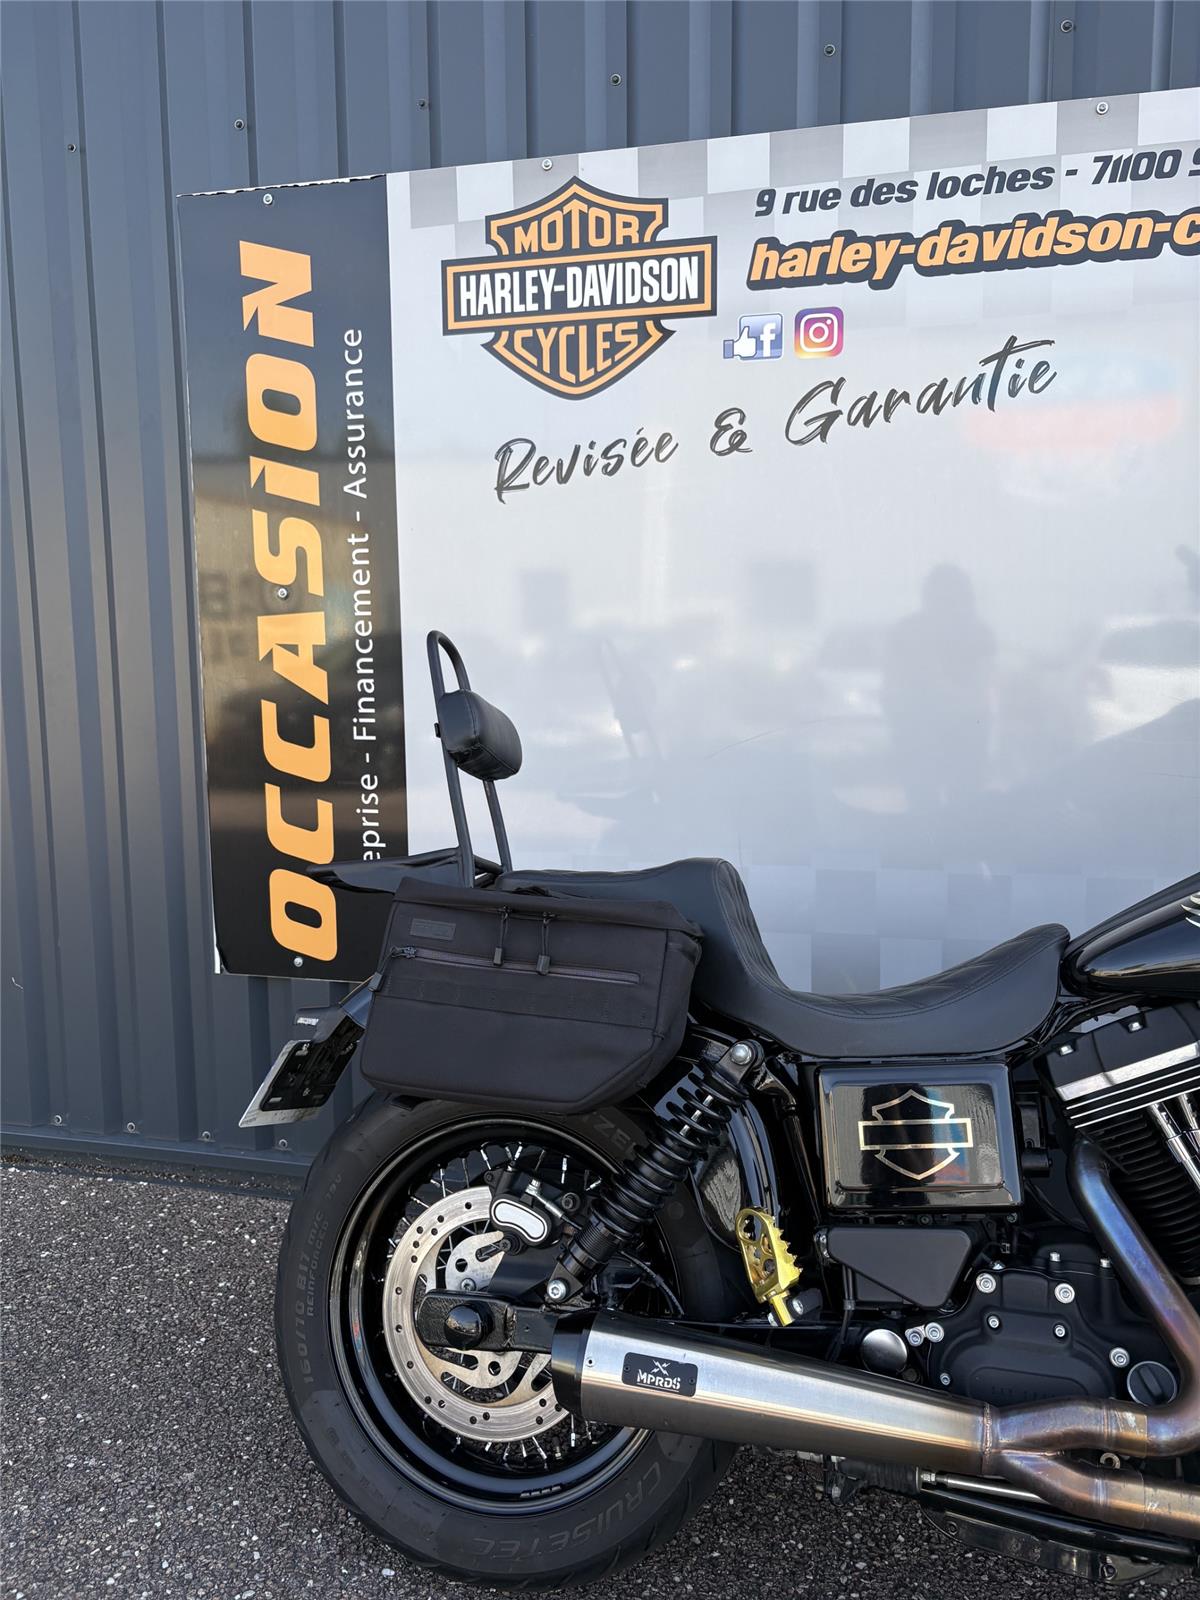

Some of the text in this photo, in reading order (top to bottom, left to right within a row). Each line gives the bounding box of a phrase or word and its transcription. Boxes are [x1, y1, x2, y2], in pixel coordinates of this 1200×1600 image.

[514, 198, 640, 255] MOTOR
[754, 188, 775, 217] 9
[783, 182, 841, 215] rue
[850, 178, 918, 208] des
[926, 164, 1055, 201] loches
[1091, 149, 1182, 185] 71100
[459, 255, 699, 317] HARLEY-DAVIDSON
[513, 321, 639, 384] CYCLES
[342, 328, 368, 499] Assurance
[493, 335, 1058, 504] Revisée & Garantie
[239, 240, 338, 962] OCCASION
[346, 532, 377, 741] Financement
[355, 773, 387, 861] eprise
